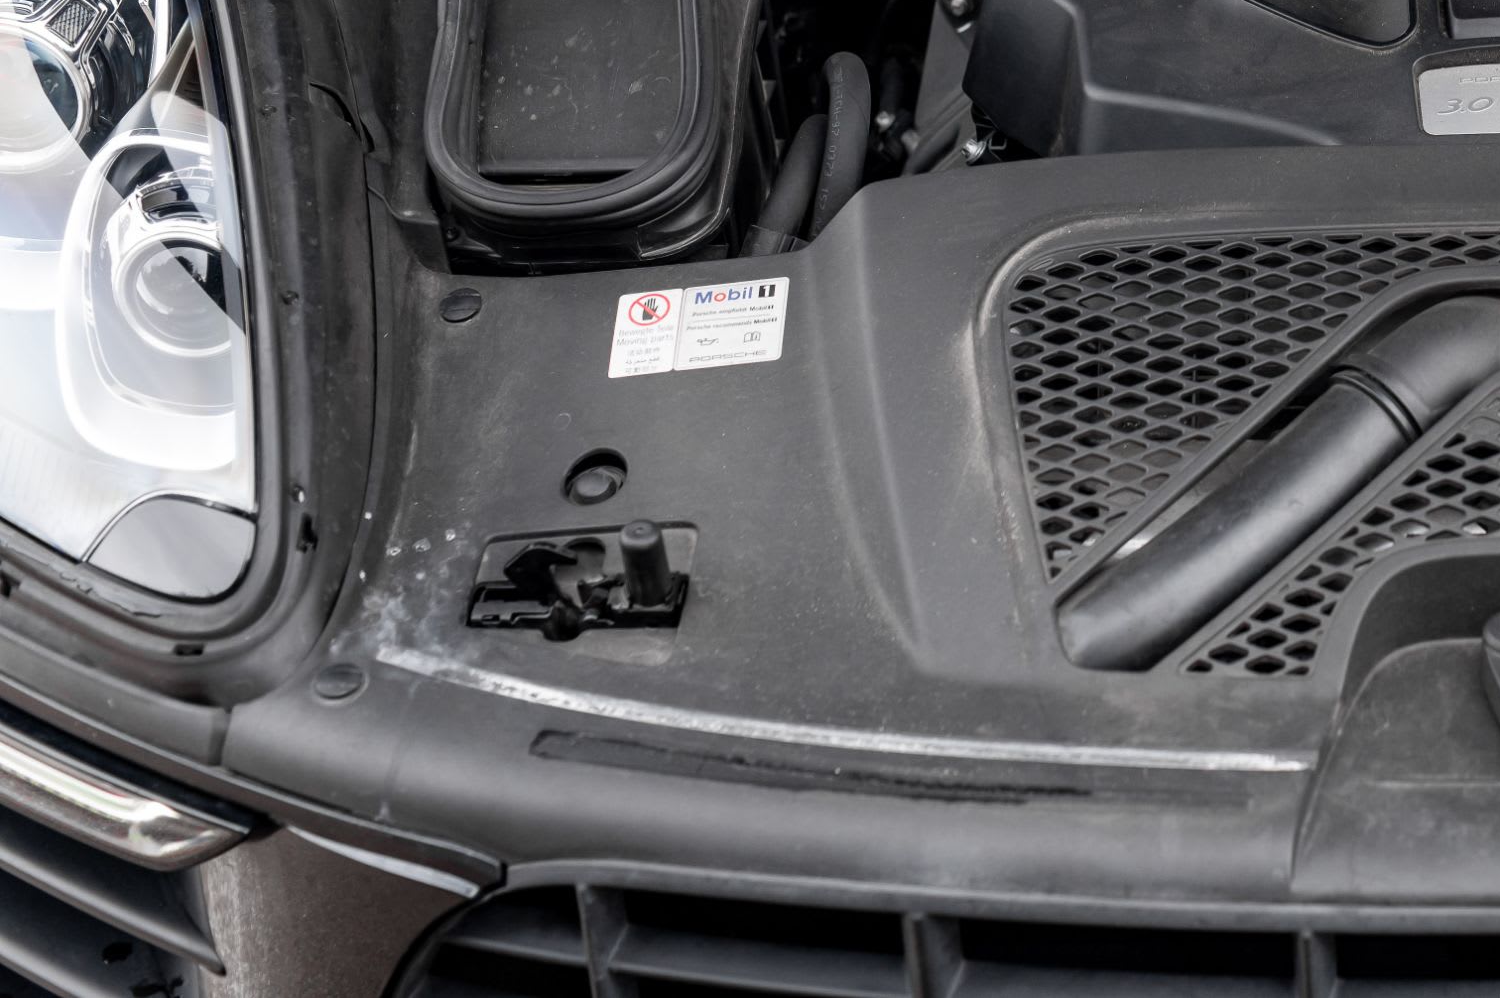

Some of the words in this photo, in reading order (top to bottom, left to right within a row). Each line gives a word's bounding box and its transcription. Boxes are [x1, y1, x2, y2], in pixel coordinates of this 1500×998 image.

[1437, 96, 1495, 116] 3.0
[695, 286, 753, 305] Mobil
[759, 284, 776, 298] 1
[689, 349, 767, 363] PORSCHE
